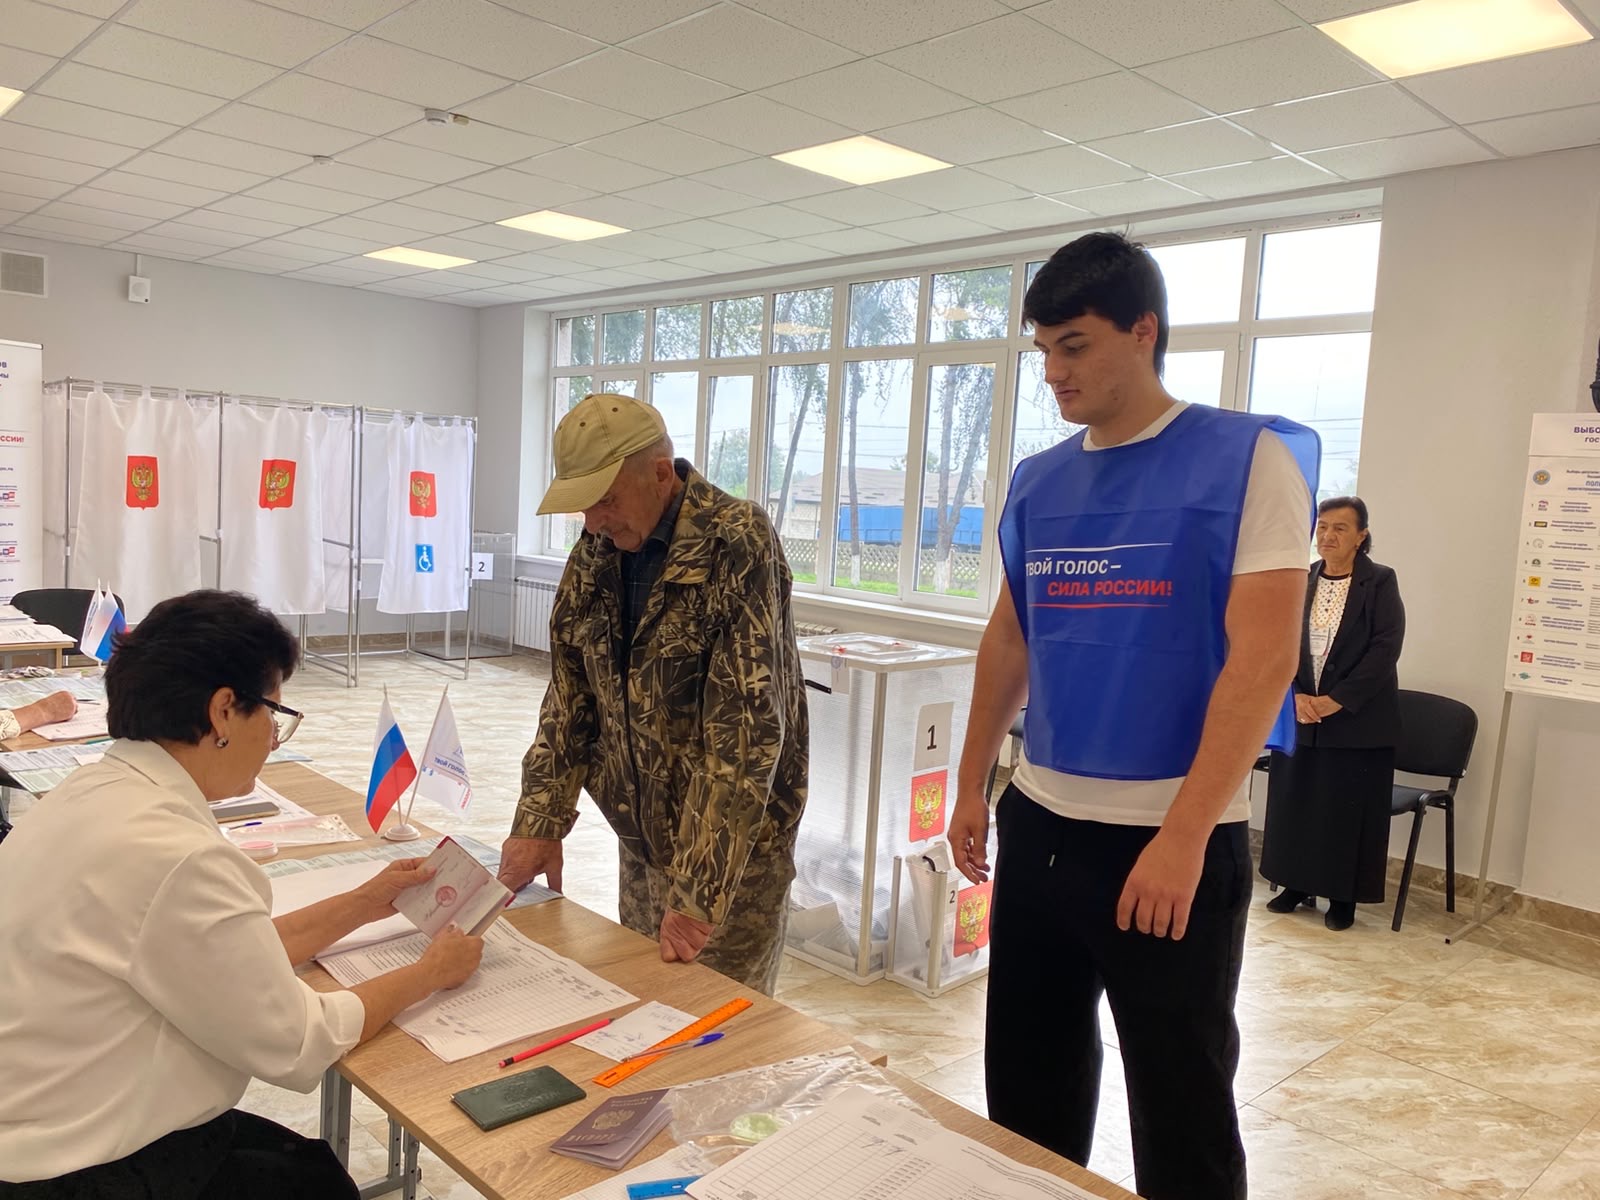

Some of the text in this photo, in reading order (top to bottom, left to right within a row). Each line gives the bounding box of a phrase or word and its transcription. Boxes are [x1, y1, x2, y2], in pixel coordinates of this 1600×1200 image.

[0, 435, 24, 443] ССИИ!
[478, 561, 485, 572] 2
[1025, 557, 1052, 577] ТВОЙ
[1047, 579, 1173, 597] СИЛА РОССИИ!
[926, 724, 938, 751] 1
[949, 890, 956, 904] 2
